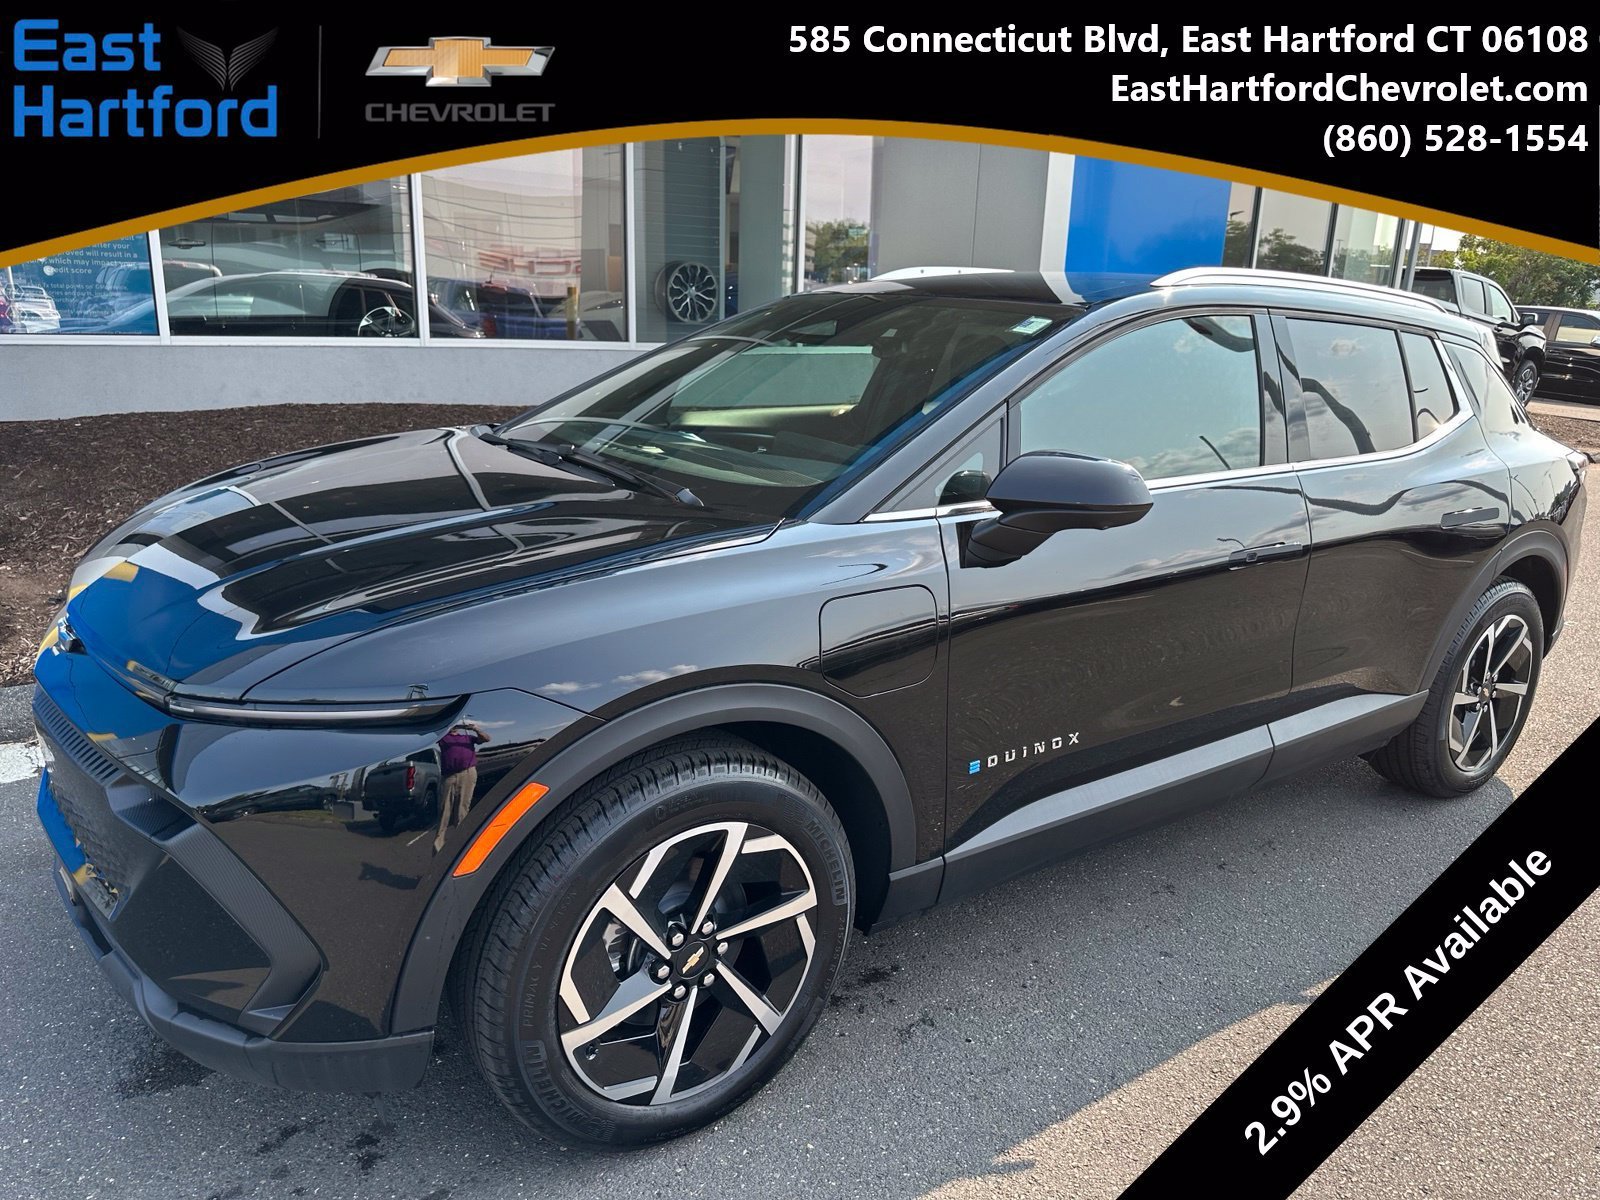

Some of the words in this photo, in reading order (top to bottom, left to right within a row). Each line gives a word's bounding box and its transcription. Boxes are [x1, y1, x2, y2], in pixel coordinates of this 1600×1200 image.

[968, 731, 1080, 775] EQUINOX
[806, 819, 846, 900] MICHELIN
[524, 1045, 588, 1124] MICHELIN
